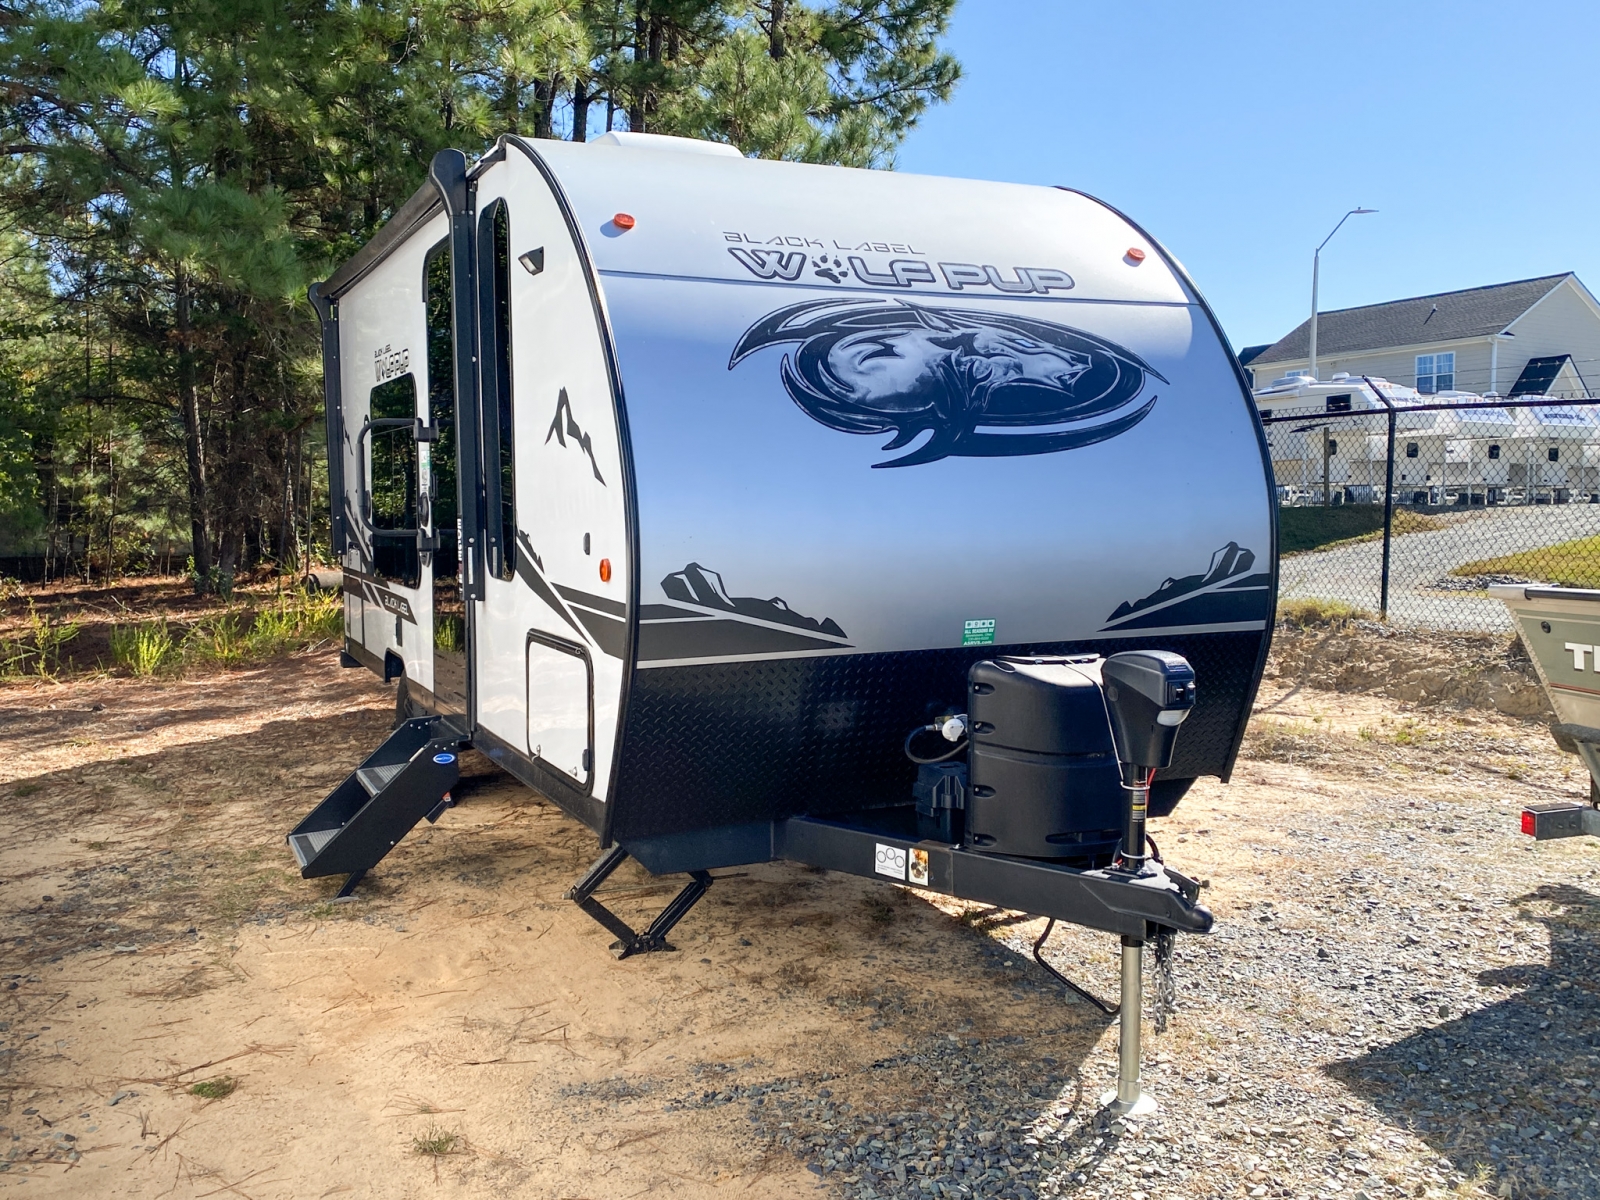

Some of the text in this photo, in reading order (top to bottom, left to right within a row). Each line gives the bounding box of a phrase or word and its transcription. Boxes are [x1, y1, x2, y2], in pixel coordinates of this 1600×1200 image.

[722, 231, 926, 255] BLACK LABEL
[937, 262, 1076, 295] PUP
